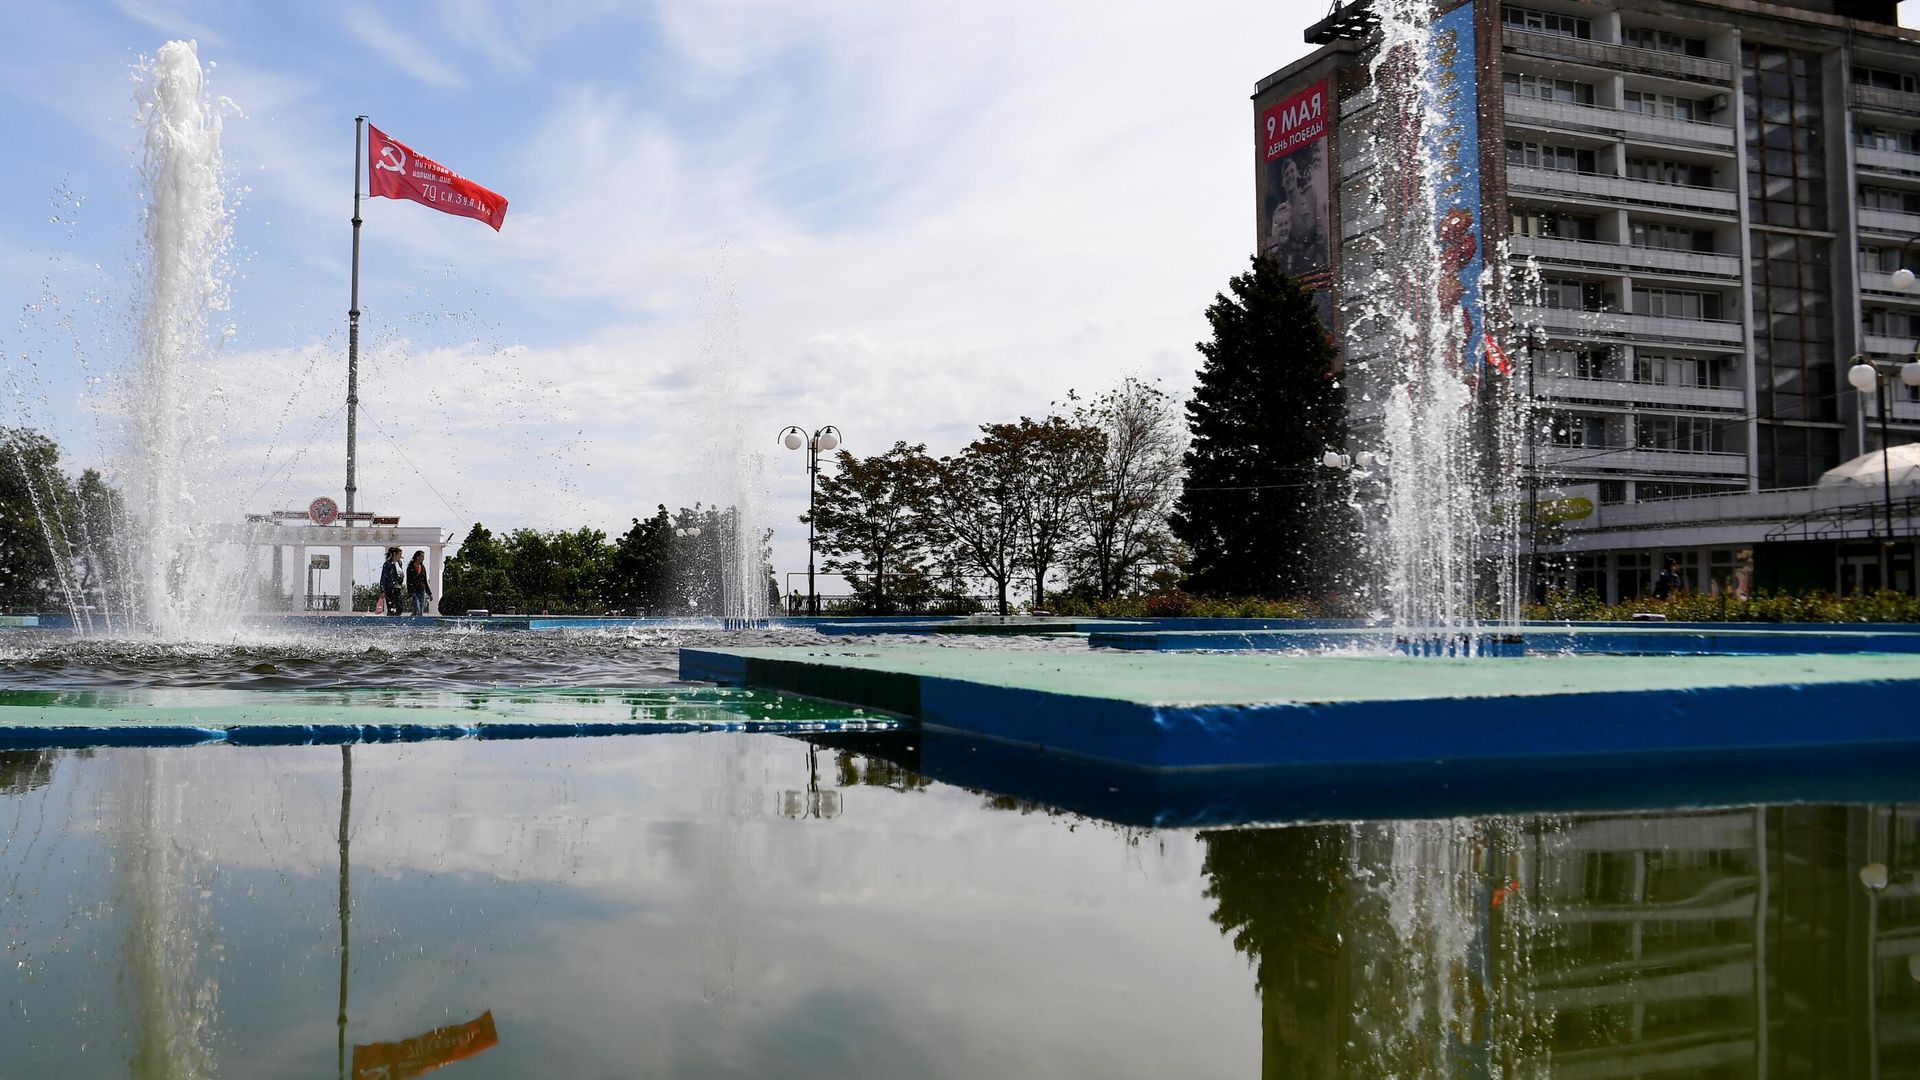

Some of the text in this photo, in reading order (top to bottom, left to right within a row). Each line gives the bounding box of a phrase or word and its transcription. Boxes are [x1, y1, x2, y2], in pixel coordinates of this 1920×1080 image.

[1267, 91, 1321, 140] 9 МАЯ
[1267, 119, 1323, 158] ДЕНЬ ПОБЕДЫ
[422, 183, 437, 202] 79
